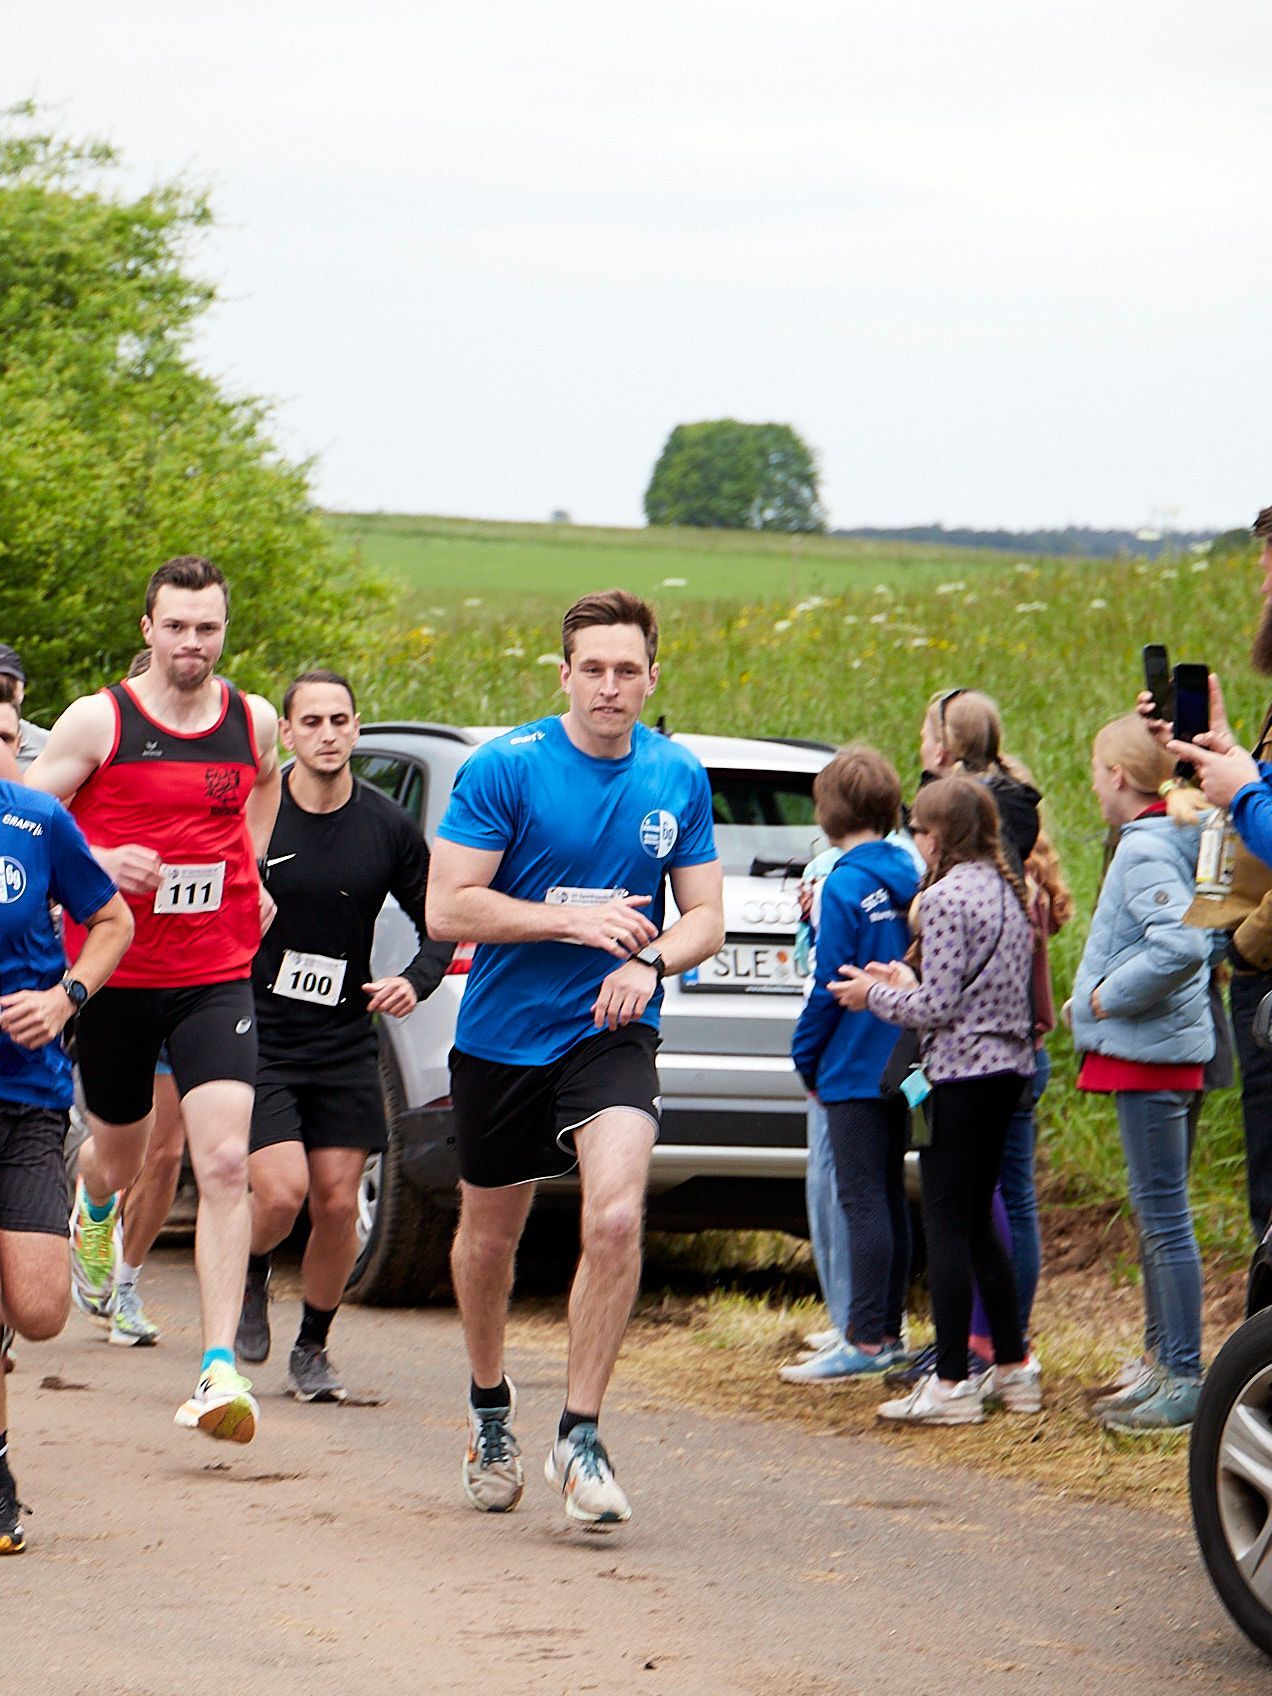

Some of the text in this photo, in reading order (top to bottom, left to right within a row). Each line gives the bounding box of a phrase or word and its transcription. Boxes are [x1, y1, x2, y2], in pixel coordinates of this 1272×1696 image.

[170, 882, 212, 905] 111
[714, 949, 771, 978] SLE
[291, 970, 332, 996] 100
